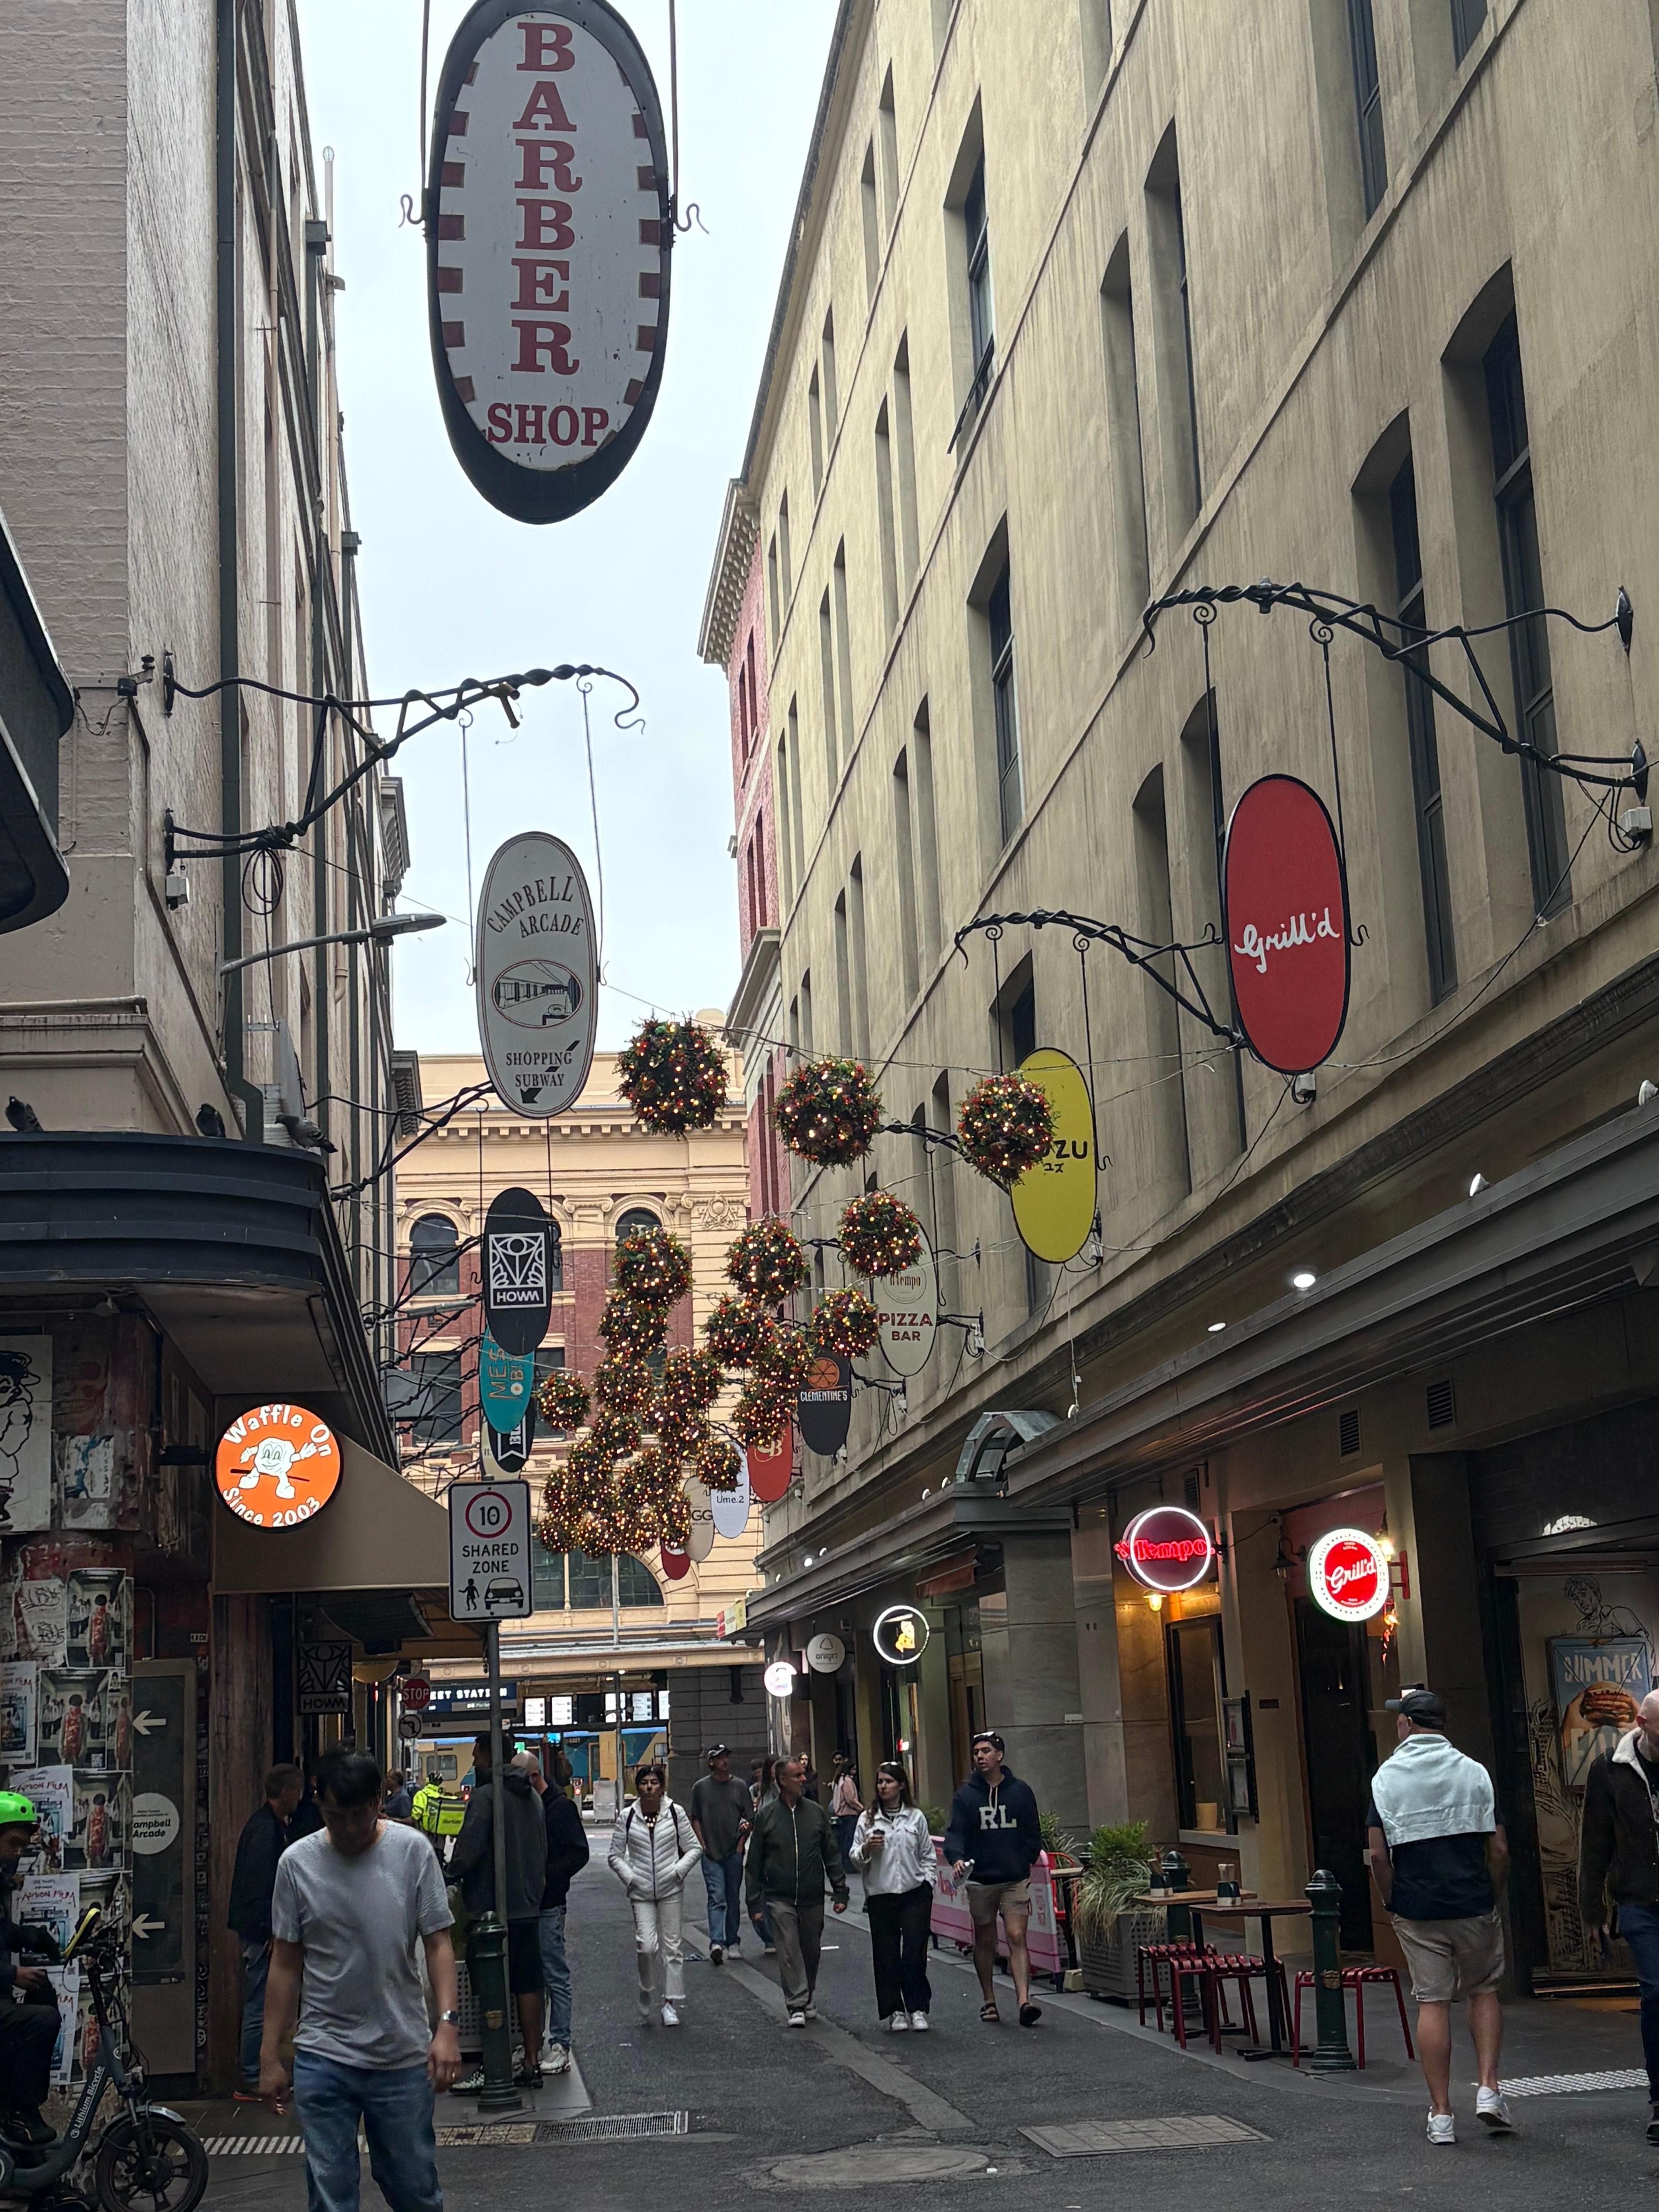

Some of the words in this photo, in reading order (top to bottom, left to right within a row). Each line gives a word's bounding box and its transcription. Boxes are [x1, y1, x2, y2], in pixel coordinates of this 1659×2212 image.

[510, 22, 582, 376] BARBER
[486, 402, 610, 447] SHOP
[487, 876, 574, 934] CAMPBELL
[519, 913, 584, 939] ARCADE
[1234, 907, 1341, 974] Grill'd
[506, 1051, 572, 1066] SHOPPING
[515, 1073, 565, 1087] SUBWAY
[879, 1313, 933, 1327] PIZZA
[891, 1331, 921, 1341] BAR
[223, 1403, 304, 1445] Waffle
[309, 1423, 332, 1457] On
[223, 1487, 264, 1525] Since
[272, 1496, 321, 1527] 2003
[479, 1506, 500, 1526] 10
[462, 1543, 519, 1557] SHARED
[472, 1560, 510, 1574] ZONE
[1326, 1555, 1378, 1594] Grill'd
[1564, 1651, 1643, 1684] SUMMER
[403, 1688, 429, 1700] STOP
[456, 1687, 507, 1699] STATIN
[134, 1819, 171, 1829] ampbell
[979, 1805, 1017, 1831] RL
[133, 1829, 166, 1838] Arcade
